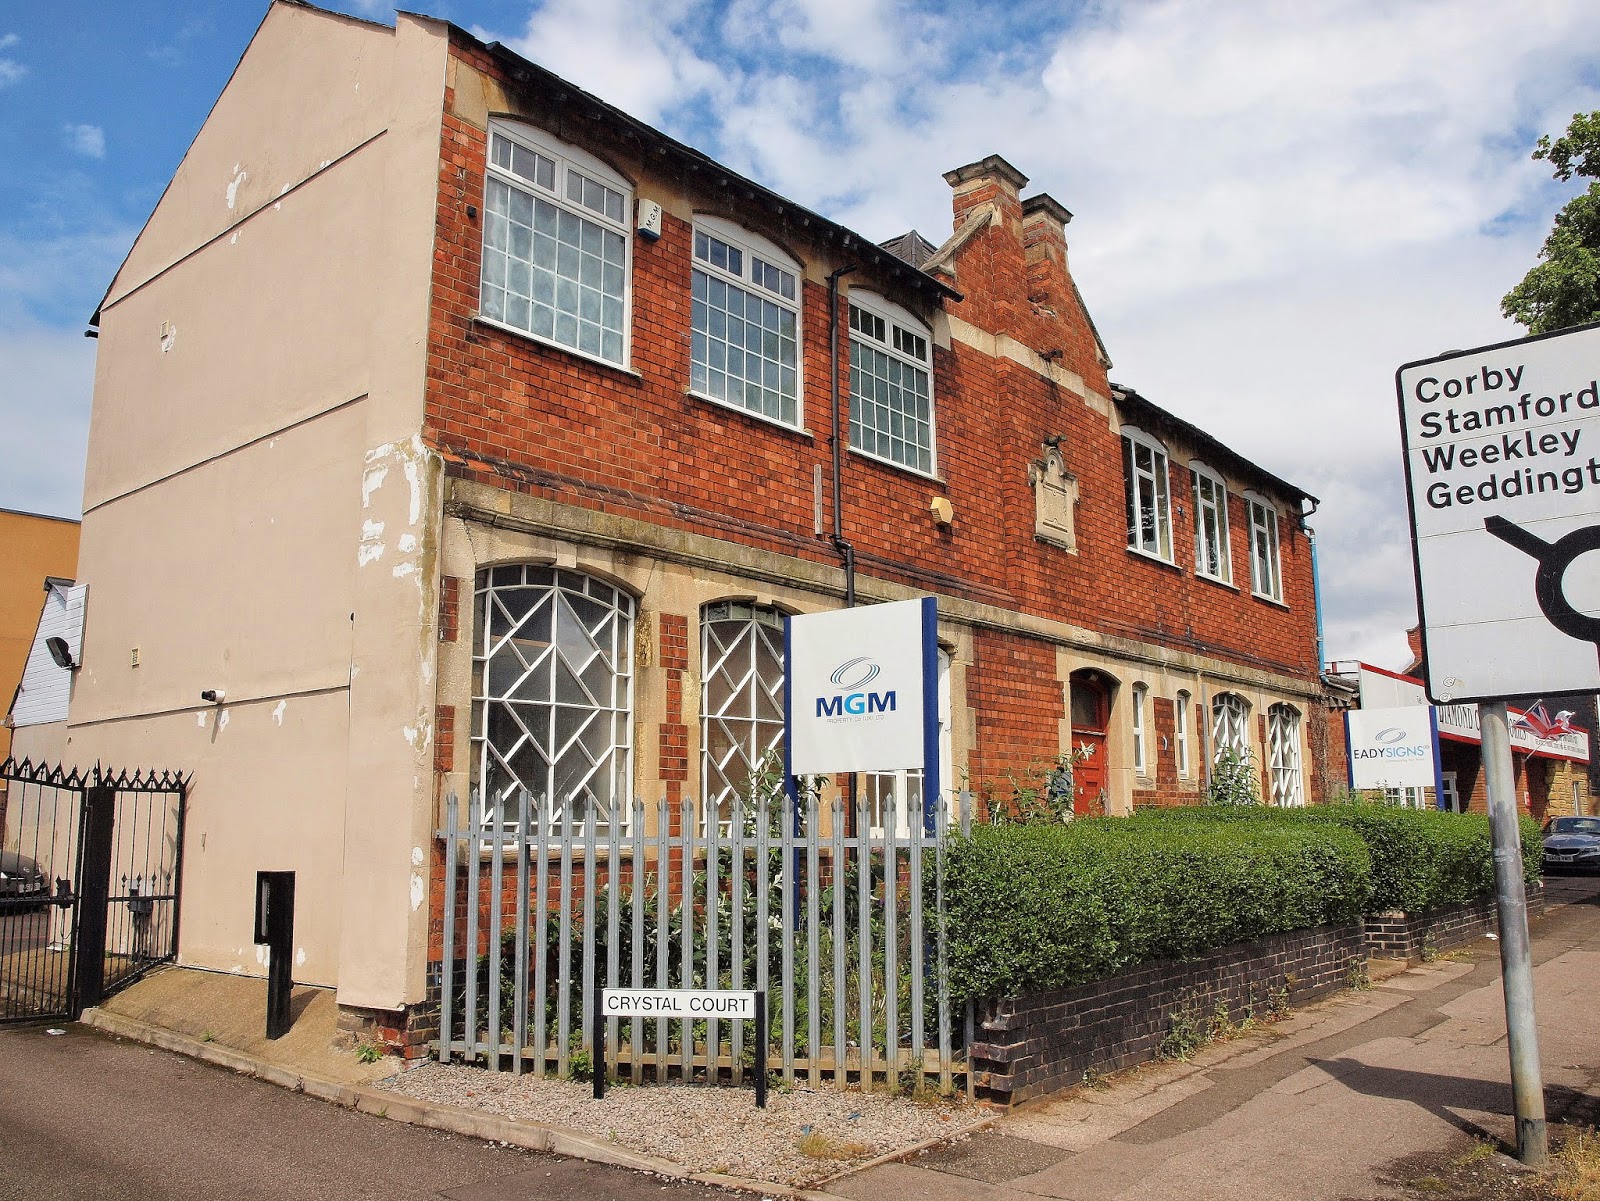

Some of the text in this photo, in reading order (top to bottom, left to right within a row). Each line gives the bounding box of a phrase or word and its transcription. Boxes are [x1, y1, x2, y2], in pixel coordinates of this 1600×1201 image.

[1415, 364, 1525, 404] Corby
[1419, 380, 1600, 439] Stamford
[1421, 428, 1582, 474] Weekley
[816, 690, 896, 717] MGM
[1353, 746, 1425, 760] EADYSIGNS
[607, 995, 749, 1012] CRYSTAL COURT
